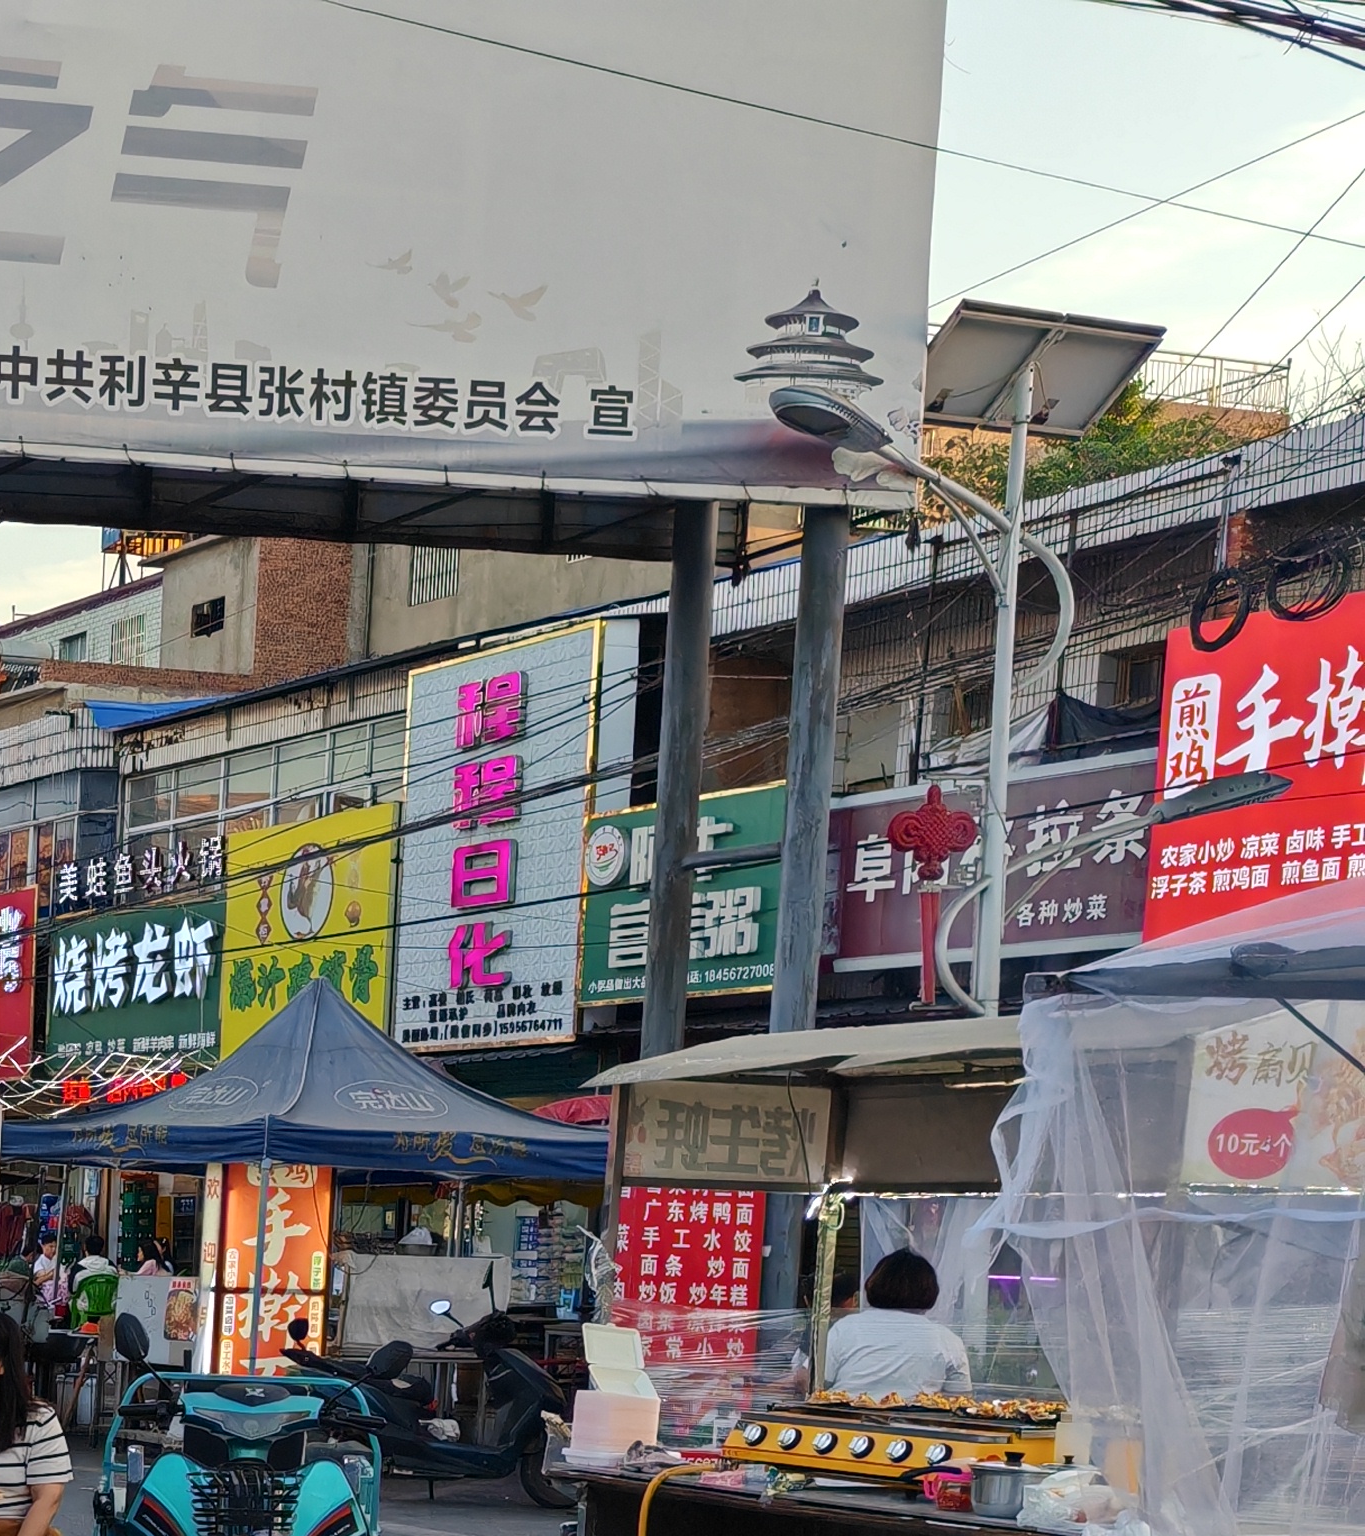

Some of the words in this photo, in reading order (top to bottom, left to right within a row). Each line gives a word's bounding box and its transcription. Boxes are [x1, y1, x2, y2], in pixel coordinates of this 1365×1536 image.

[589, 384, 635, 438] 宣
[1166, 686, 1210, 790] 煎鸡
[1160, 837, 1236, 869] 农家小炒
[1240, 831, 1281, 860] 凉菜
[1286, 827, 1326, 855] 卤味
[1331, 823, 1365, 849] 手工
[58, 835, 224, 905] 美蛙鱼头火锅
[1150, 871, 1208, 900] 浮子茶
[1212, 863, 1271, 894] 煎鸡面
[1281, 856, 1343, 886] 煎鱼面
[1016, 893, 1108, 928] 各种炒菜
[53, 915, 218, 1017] 烧烤龙虾
[353, 1087, 434, 1113] 完达山
[643, 1199, 755, 1227] 广东烤鸭面
[641, 1225, 753, 1253] 手工水饺
[640, 1253, 683, 1278] 面条
[706, 1255, 751, 1280] 炒面
[638, 1281, 677, 1304] 炒饭
[688, 1284, 749, 1308] 炒年糕
